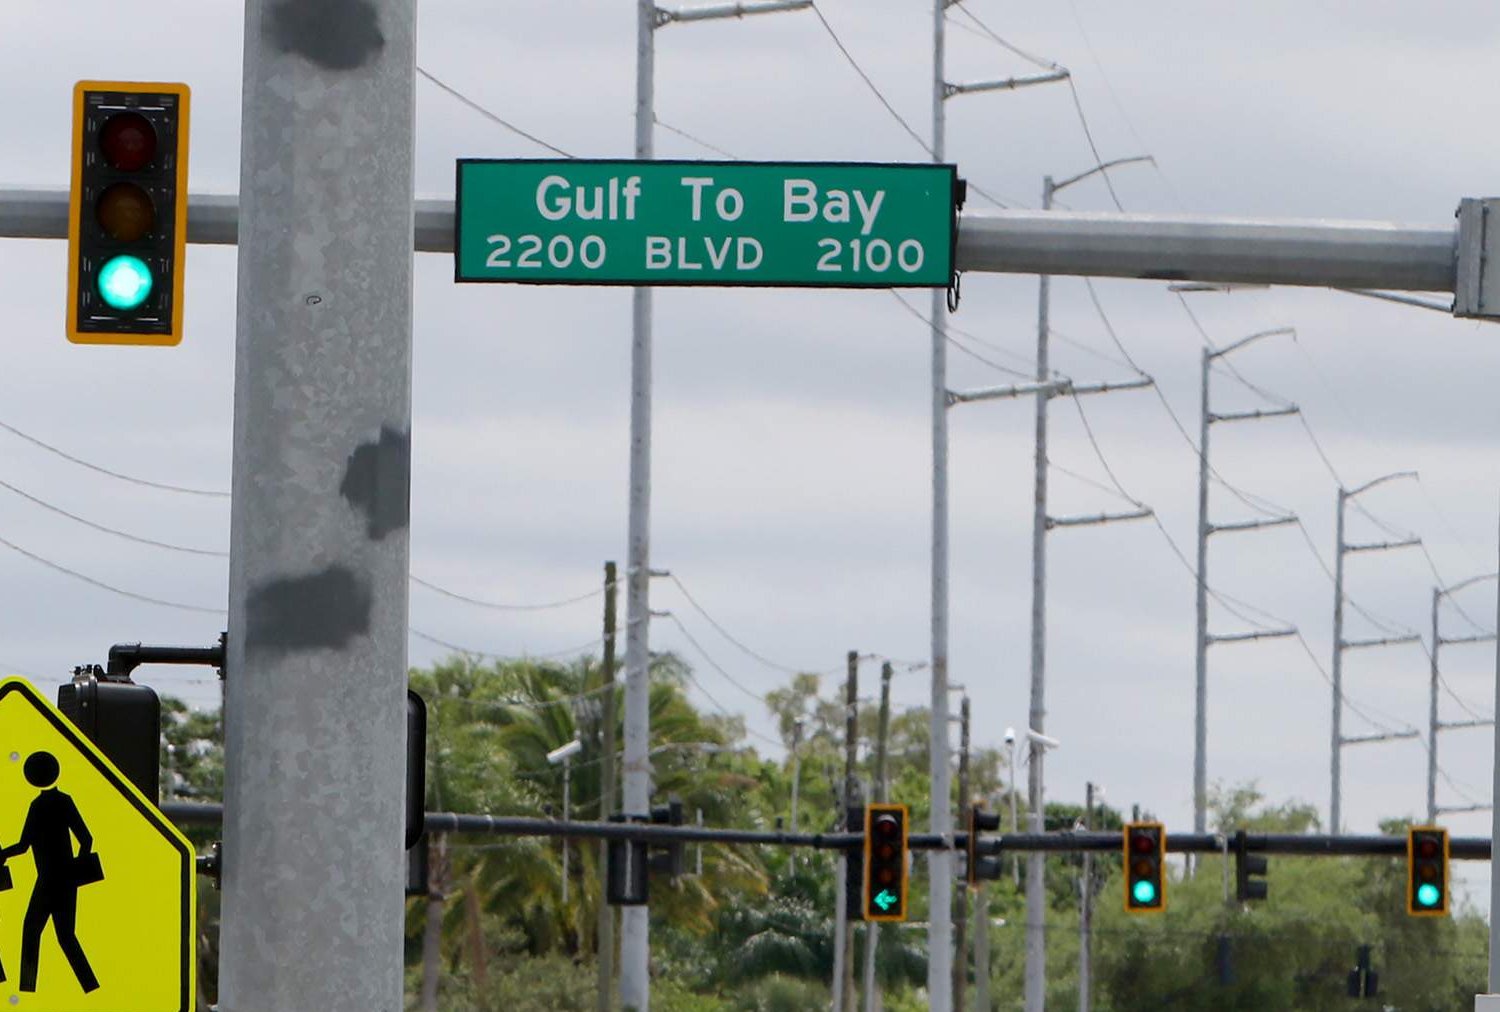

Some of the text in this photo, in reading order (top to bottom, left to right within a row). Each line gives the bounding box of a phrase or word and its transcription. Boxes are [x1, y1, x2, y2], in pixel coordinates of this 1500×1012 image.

[535, 175, 885, 235] Gulf To Bay
[485, 234, 925, 273] 2200 BLVD 2100
